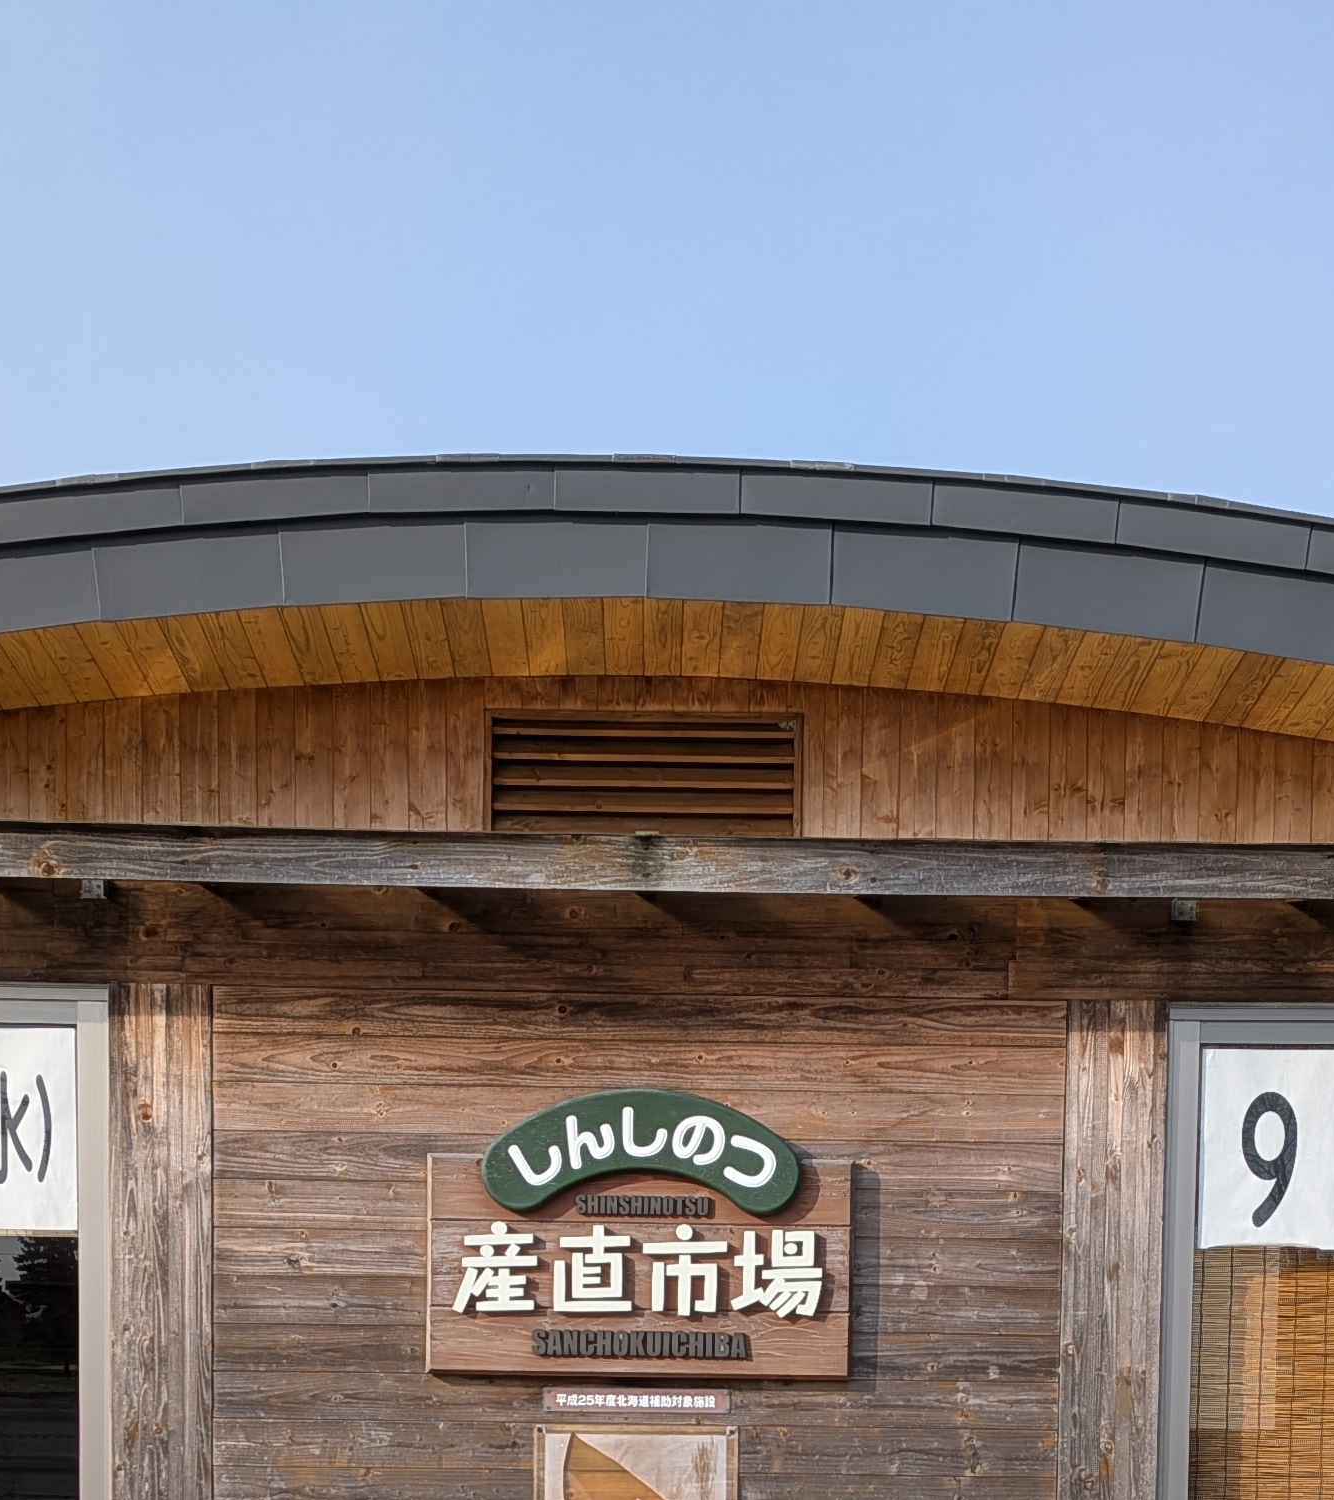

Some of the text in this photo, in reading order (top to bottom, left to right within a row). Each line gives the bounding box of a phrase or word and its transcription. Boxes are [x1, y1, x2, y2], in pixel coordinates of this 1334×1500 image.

[507, 1106, 777, 1188] しんしのつ
[574, 1194, 711, 1217] SHINSHINOTSU
[452, 1222, 824, 1318] 産直市場
[532, 1328, 748, 1360] SANCHOKUICHIBA
[555, 1393, 716, 1409] 平成25年度北海道補助対象施設
